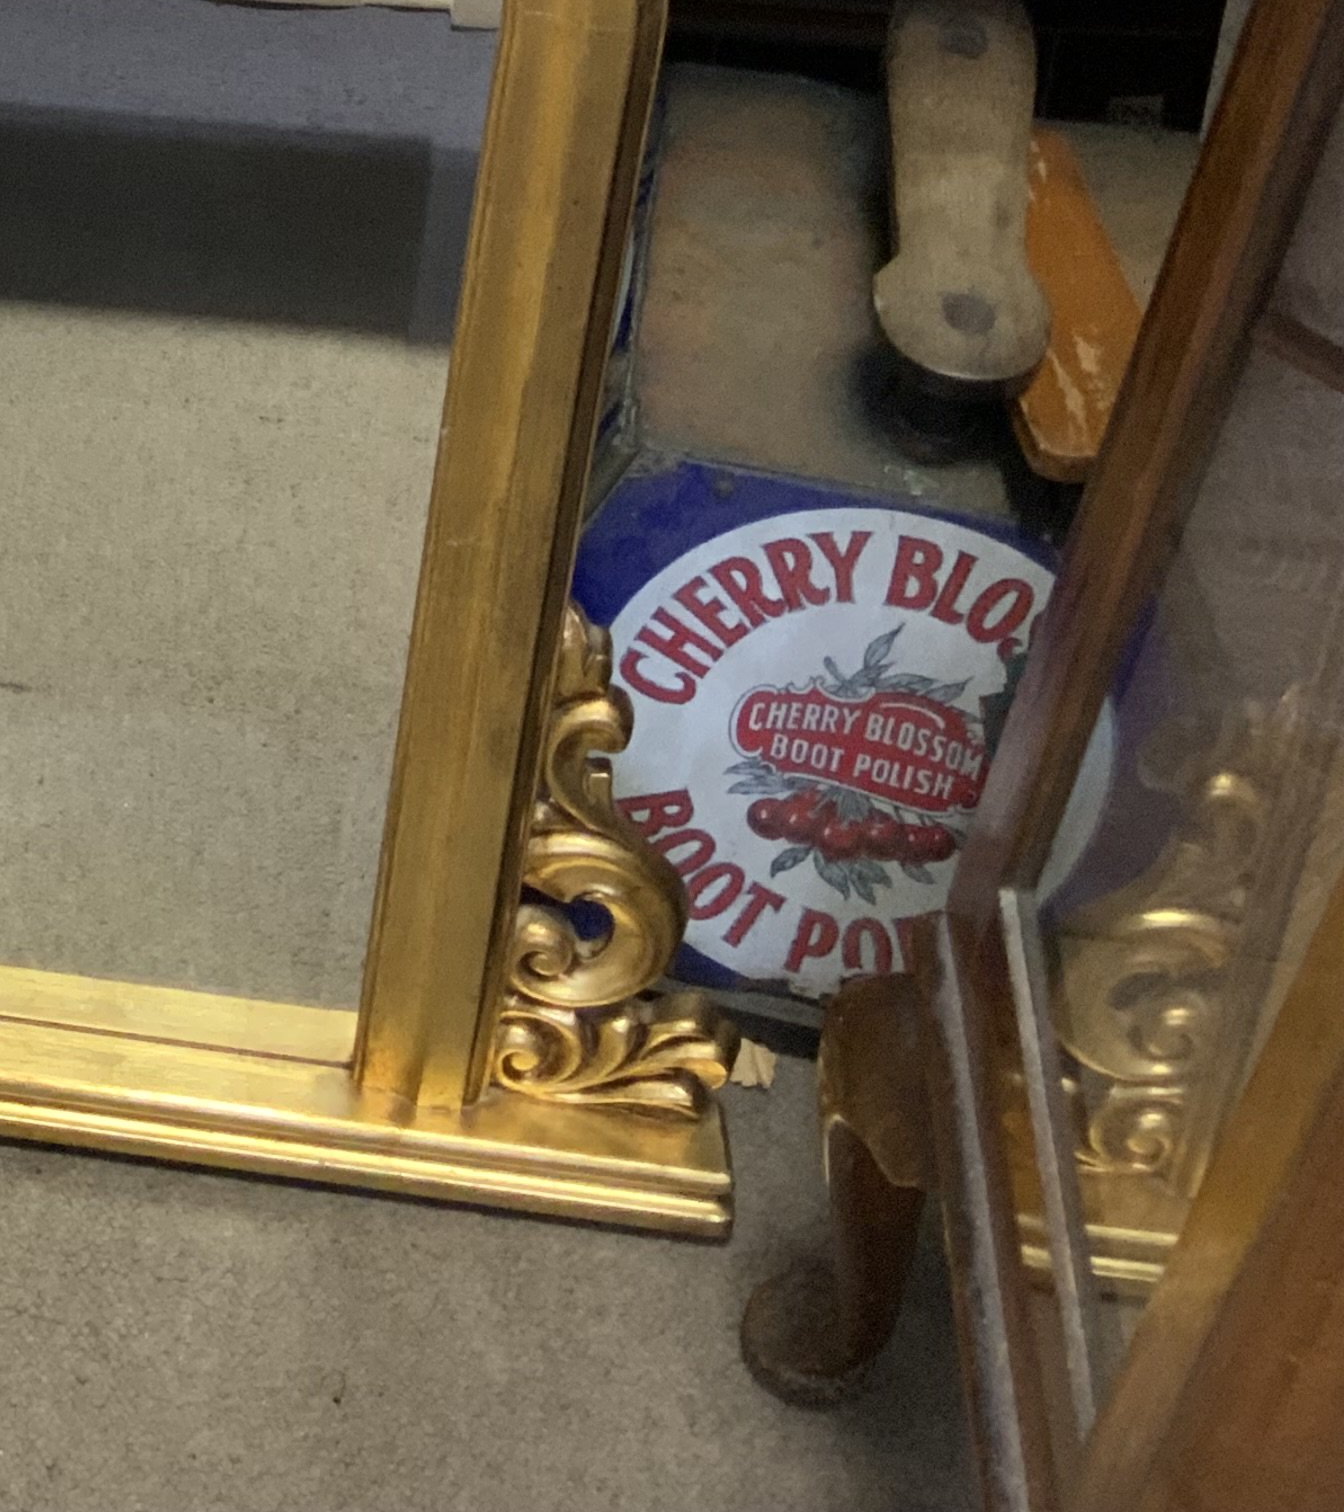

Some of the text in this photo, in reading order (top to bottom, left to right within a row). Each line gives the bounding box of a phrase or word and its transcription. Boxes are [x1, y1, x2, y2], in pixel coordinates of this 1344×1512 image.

[619, 531, 1036, 705] CHERRY BLO
[748, 700, 985, 782] CHERRY BLOSSOM
[770, 735, 955, 800] BOOT POLISH
[615, 787, 788, 949] BOOT
